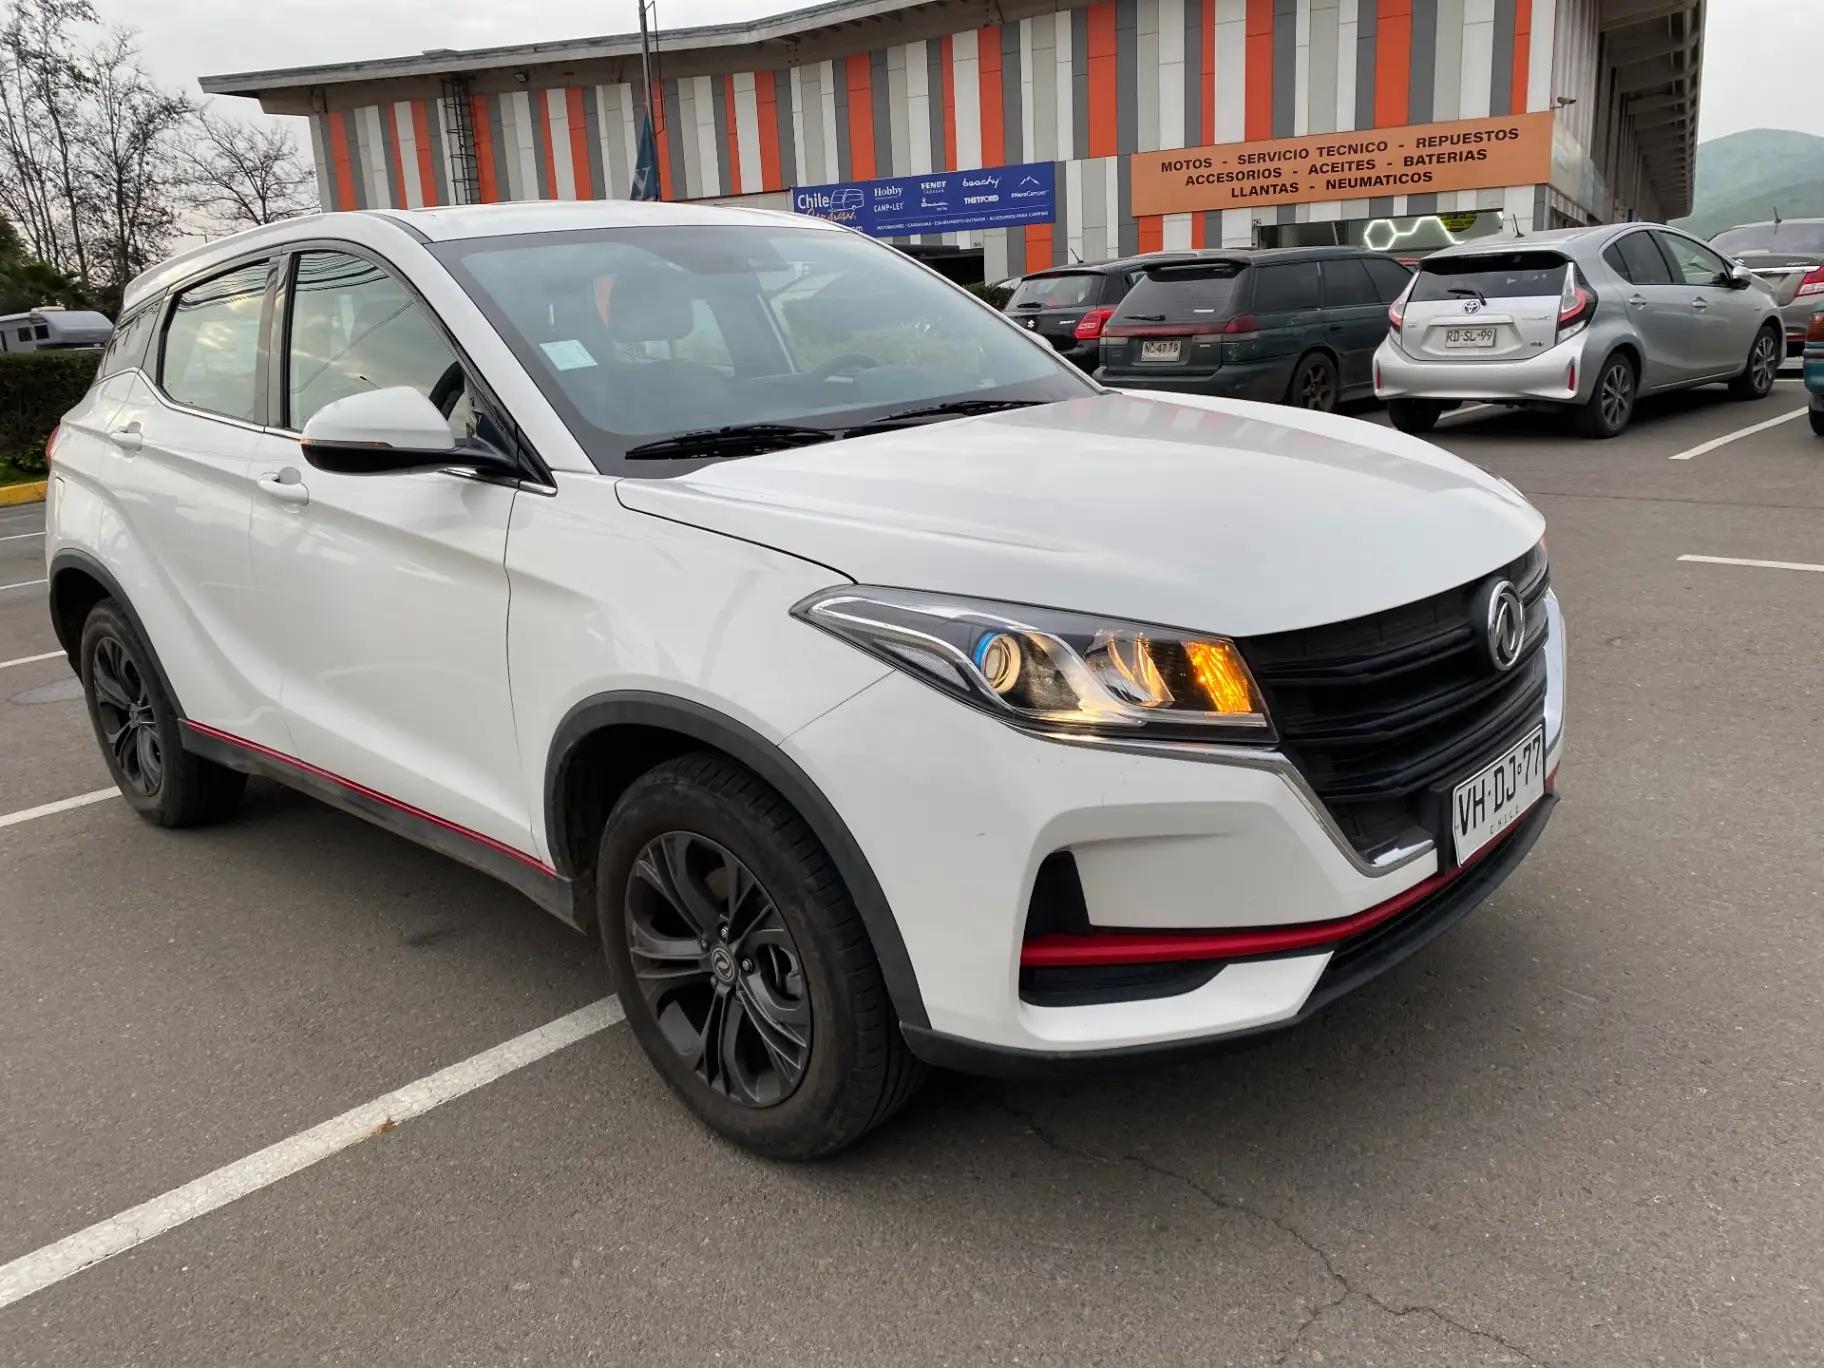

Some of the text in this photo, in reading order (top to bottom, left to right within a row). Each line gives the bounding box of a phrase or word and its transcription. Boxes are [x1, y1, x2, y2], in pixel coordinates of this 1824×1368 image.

[1161, 158, 1212, 173] MOTOS
[1237, 148, 1310, 165] SERVICIO
[1316, 141, 1388, 158] TECNICO
[1416, 128, 1519, 149] REPUESTOS
[1185, 167, 1282, 186] ACCESORIOS
[1308, 159, 1376, 175] ACEITES
[1404, 149, 1487, 167] BATERIAS
[921, 181, 947, 190] FENDT
[962, 175, 1000, 189] beachy
[1231, 182, 1299, 198] LLANTAS
[1326, 171, 1433, 190] NEUMATICOS
[874, 185, 903, 197] Hobby
[797, 193, 830, 209] Chile
[964, 194, 1000, 204] THETFORD
